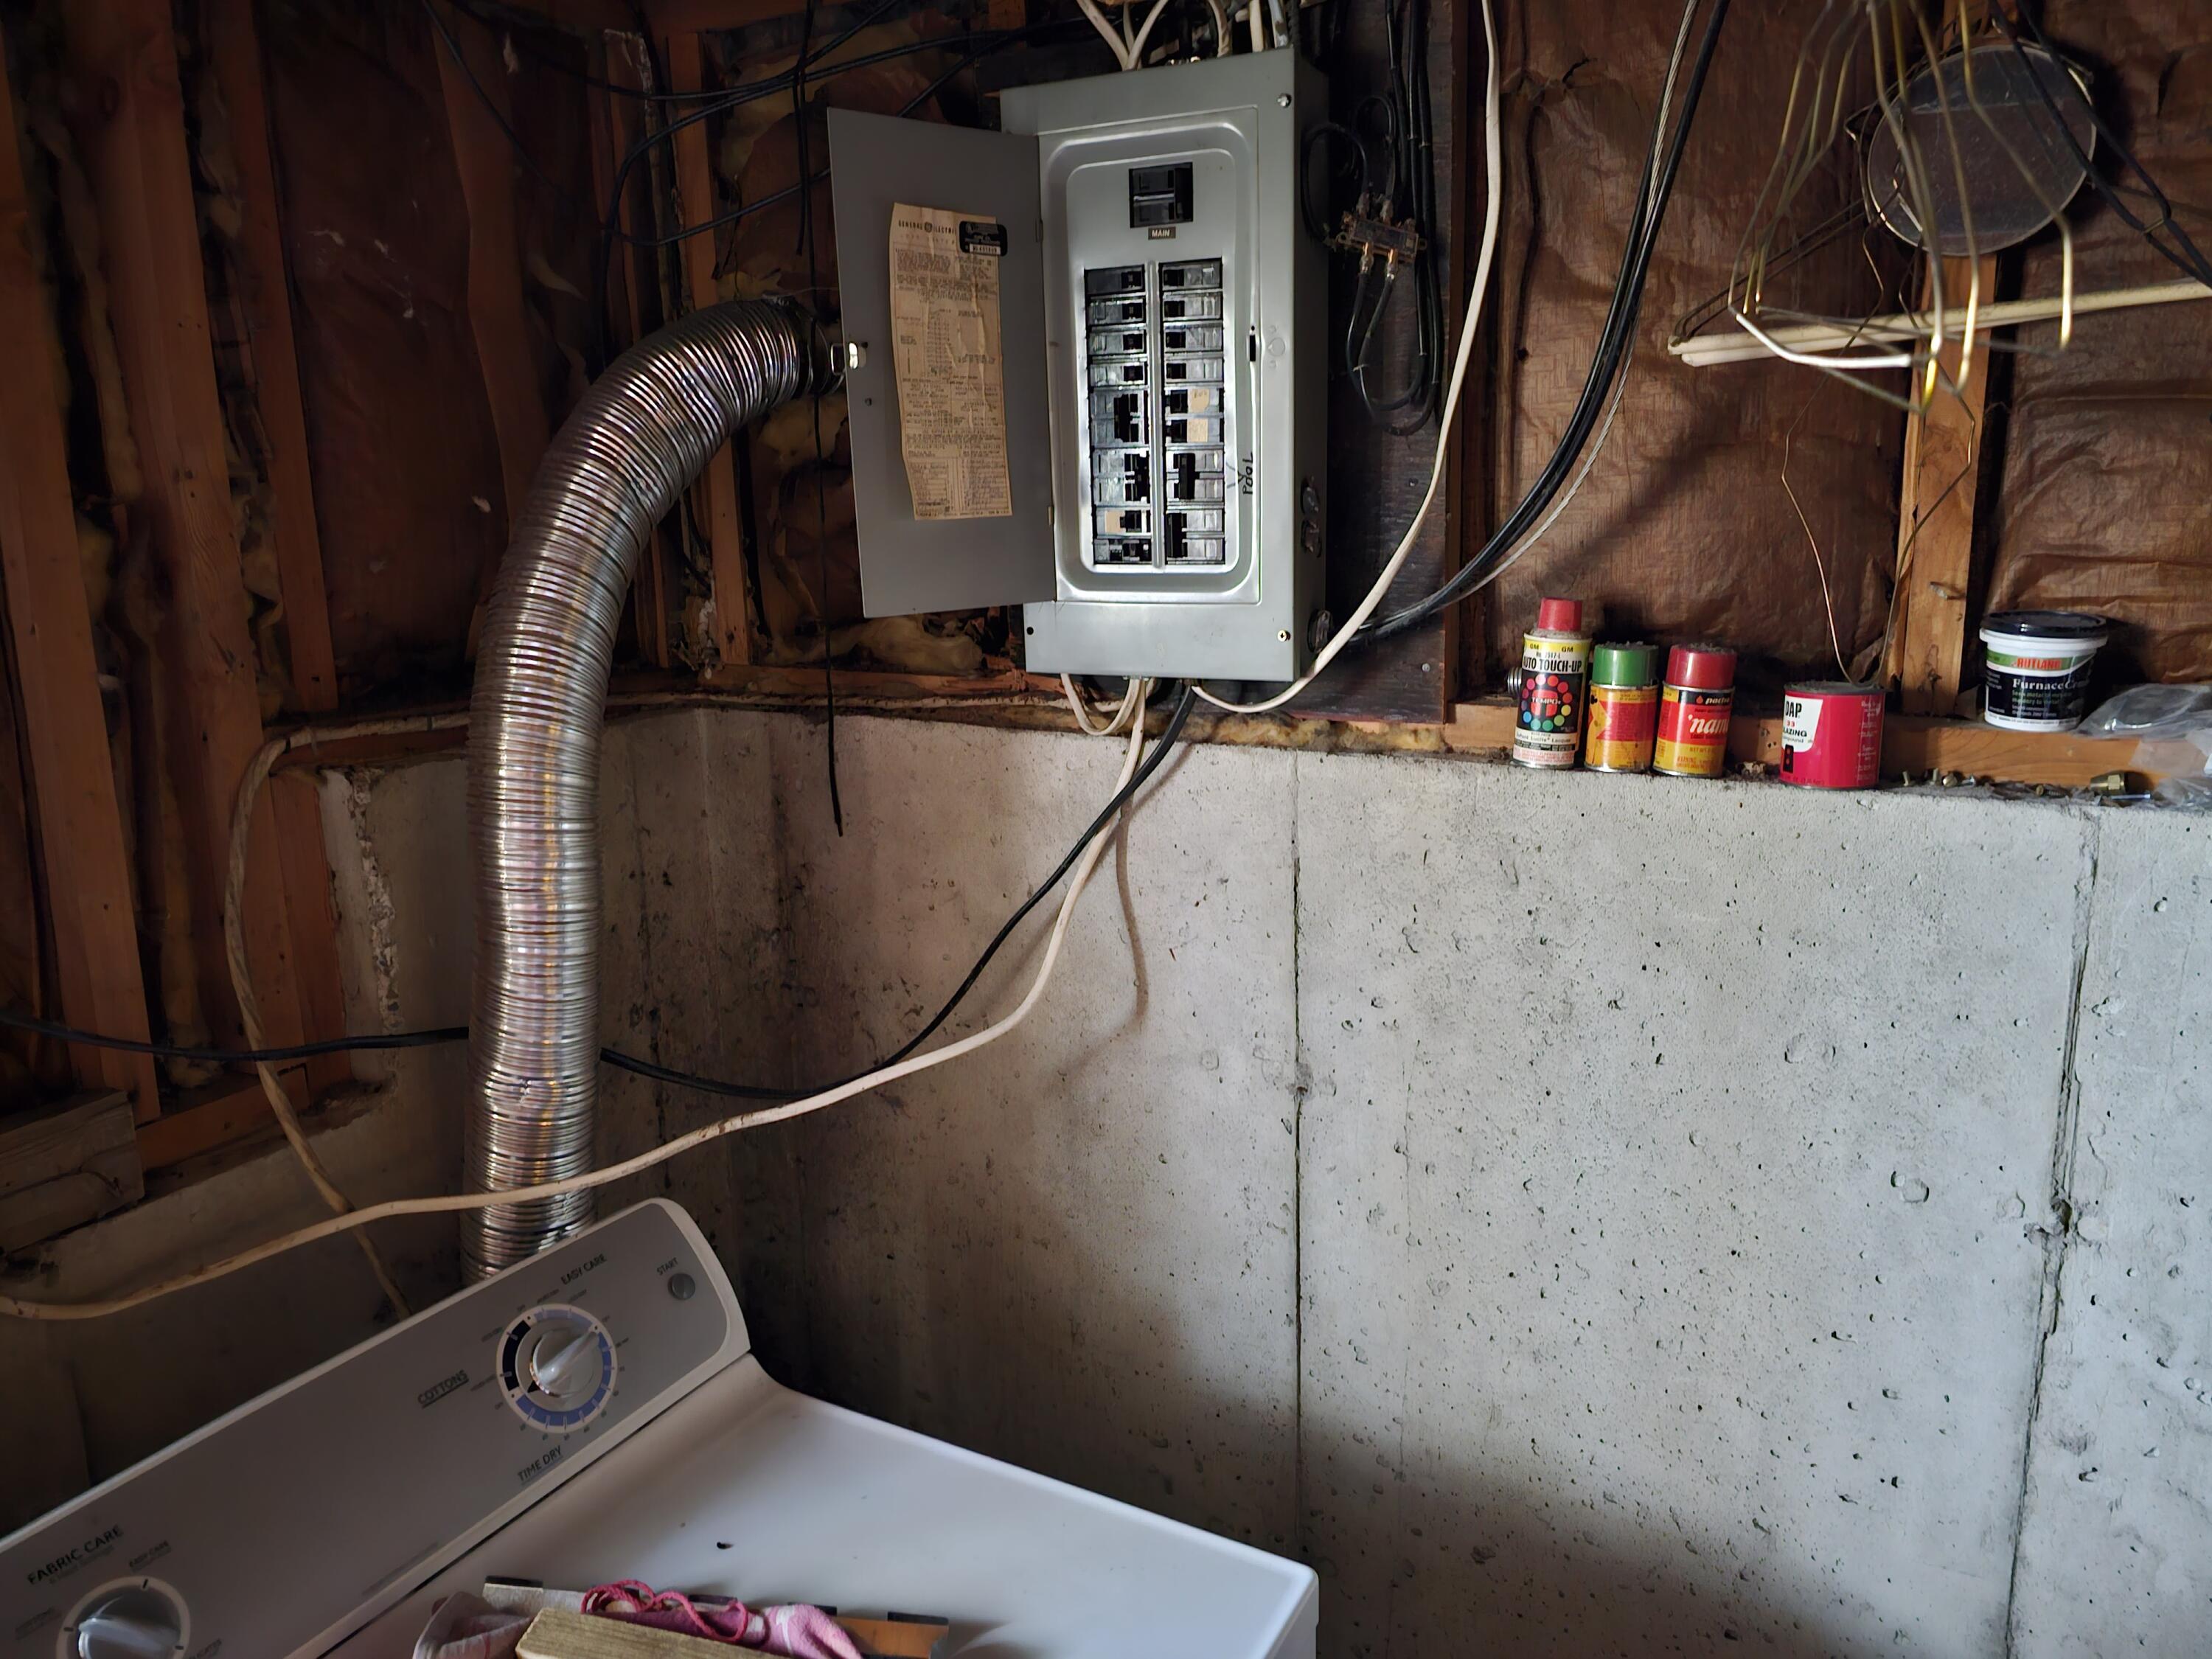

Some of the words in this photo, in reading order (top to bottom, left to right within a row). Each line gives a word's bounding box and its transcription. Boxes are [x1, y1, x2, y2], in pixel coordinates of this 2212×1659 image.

[1151, 229, 1170, 237] MAIN
[1539, 658, 1582, 672] TOUCH-UP
[2017, 657, 2063, 671] RUTLAND
[2013, 678, 2064, 691] Furnace
[1785, 701, 1802, 718] DAP
[560, 1266, 583, 1285] EASY
[583, 1253, 608, 1272] CARE
[656, 1256, 679, 1276] START
[417, 1369, 468, 1405] COTTONS
[518, 1459, 542, 1482] TIME
[542, 1445, 563, 1465] DRY
[27, 1548, 83, 1585] FABRIC
[83, 1524, 125, 1554] CARE
